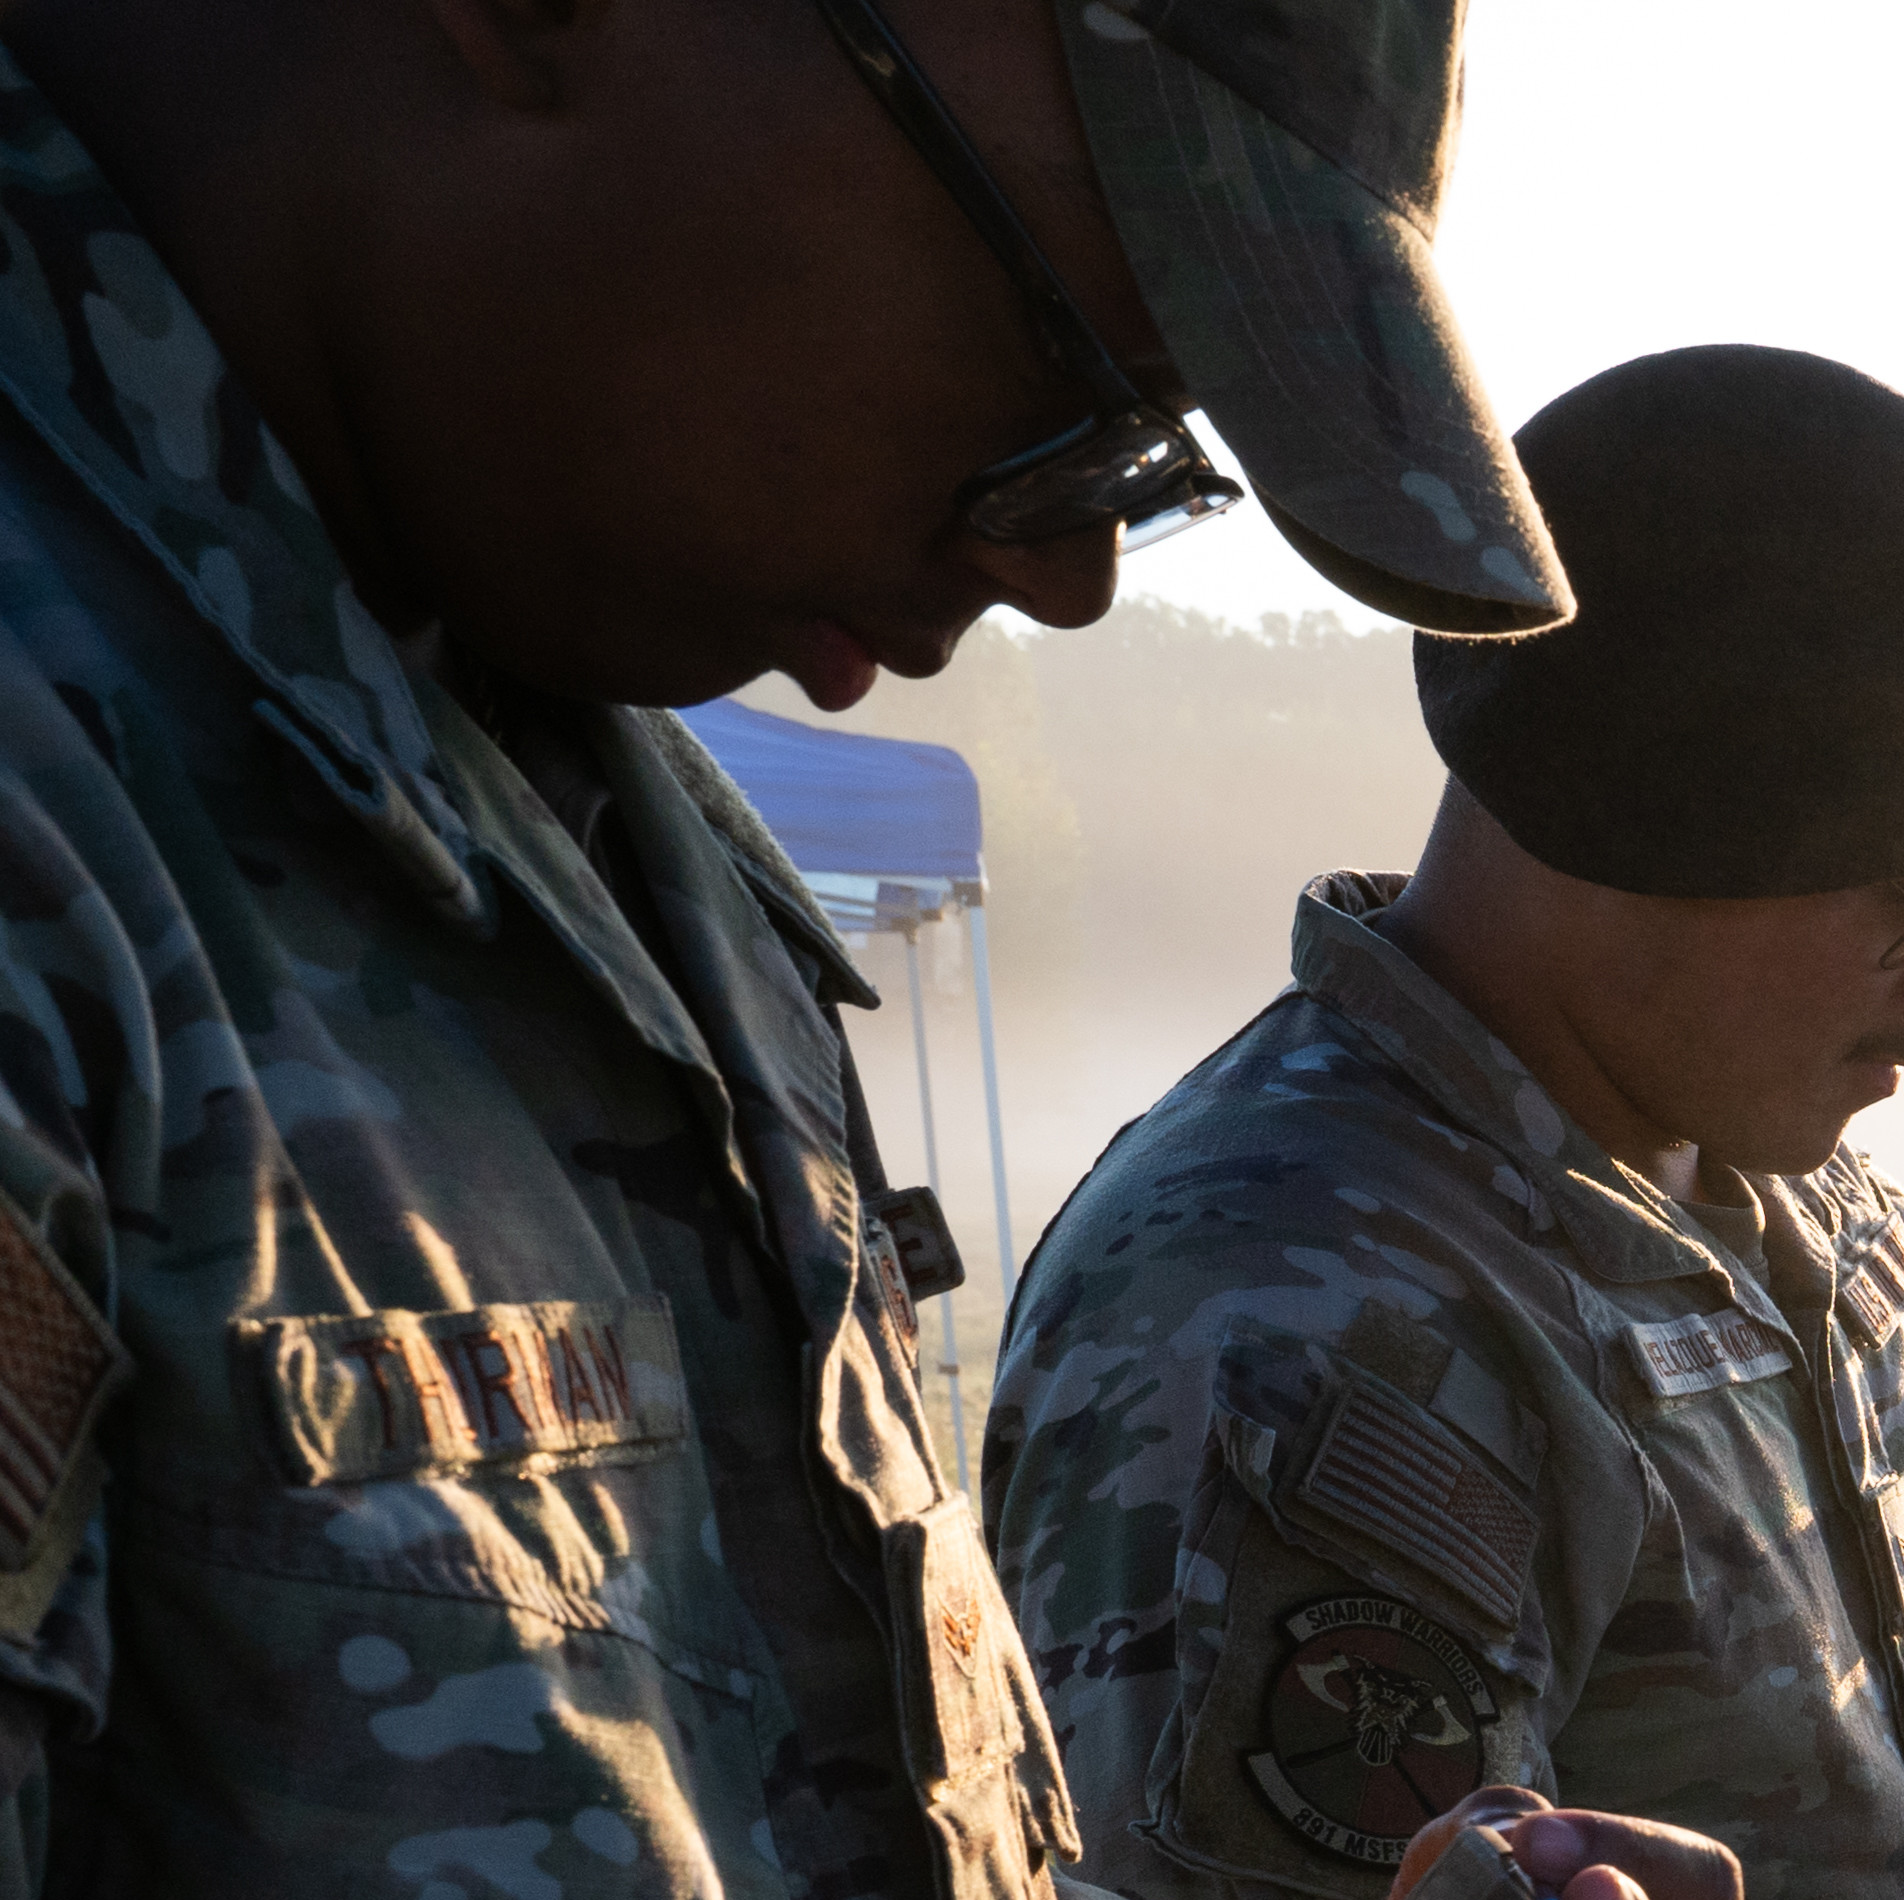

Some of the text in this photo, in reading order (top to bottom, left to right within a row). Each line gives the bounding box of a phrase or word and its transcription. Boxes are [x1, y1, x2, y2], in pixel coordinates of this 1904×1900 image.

[1304, 1601, 1485, 1696] SHADOW WARRIORS
[1292, 1806, 1334, 1844] 891
